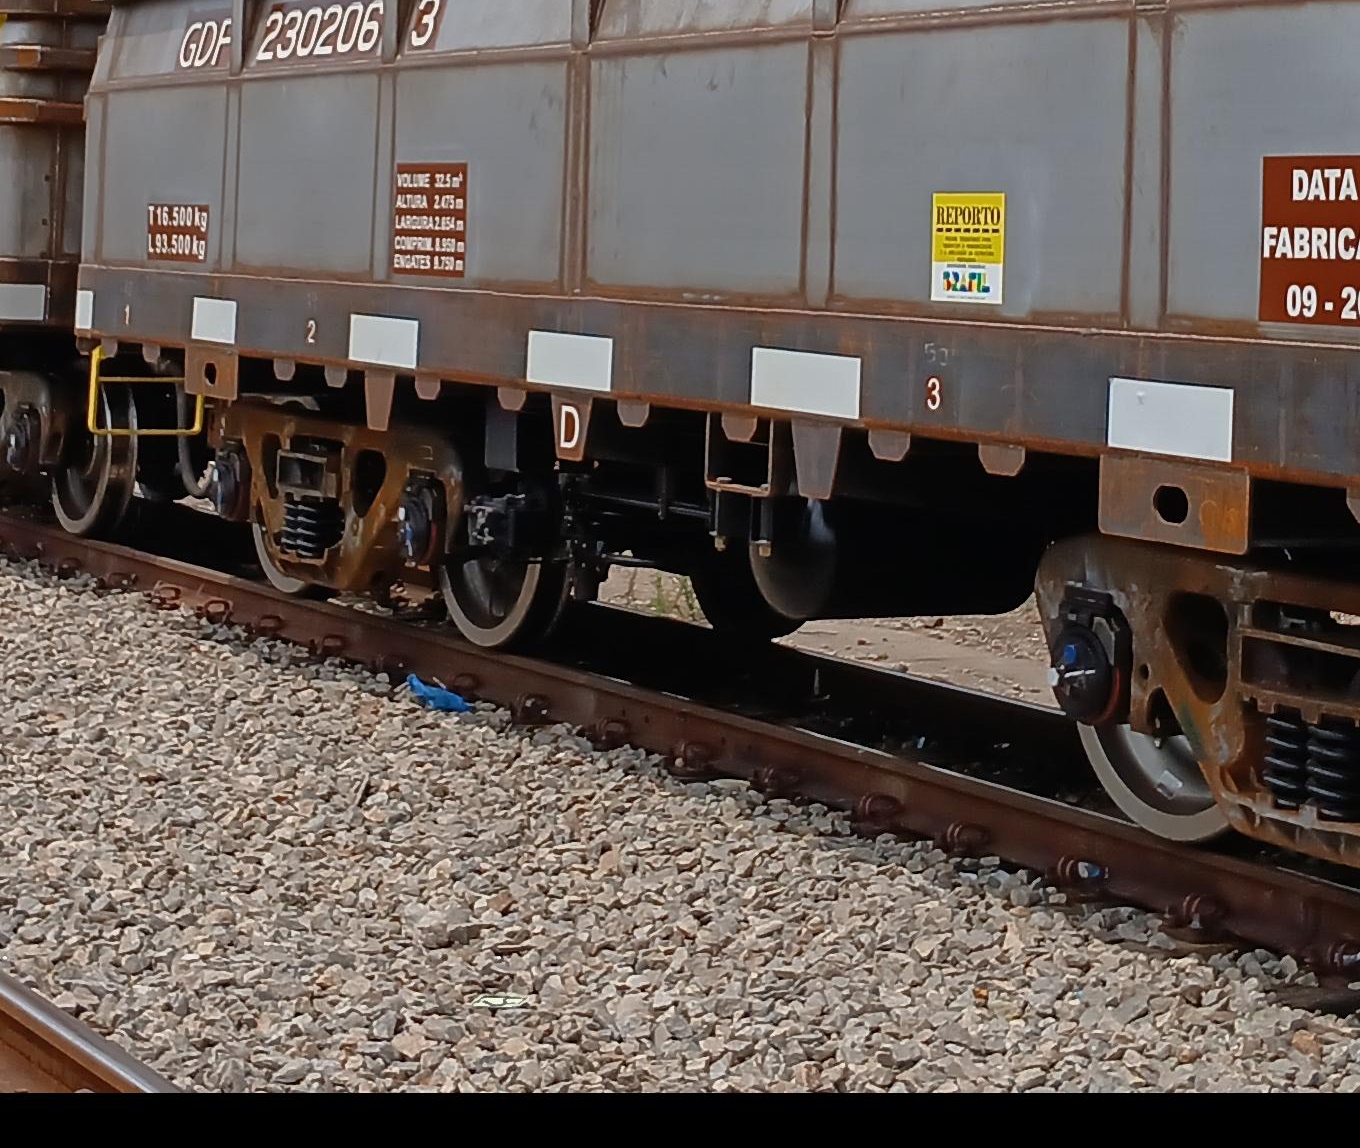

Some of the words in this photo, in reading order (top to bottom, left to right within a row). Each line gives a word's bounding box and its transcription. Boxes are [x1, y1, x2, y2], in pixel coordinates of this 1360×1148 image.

[256, 0, 384, 61] 230206
[397, 173, 431, 188] VOLUME
[1292, 168, 1358, 201] DATA
[396, 194, 428, 209] ALTURA
[194, 206, 208, 232] kg
[936, 205, 1001, 226] REPORTO
[192, 234, 206, 260] kg
[1286, 284, 1317, 318] 09
[306, 319, 316, 343] 2
[927, 377, 940, 410] 3
[560, 404, 580, 449] D
